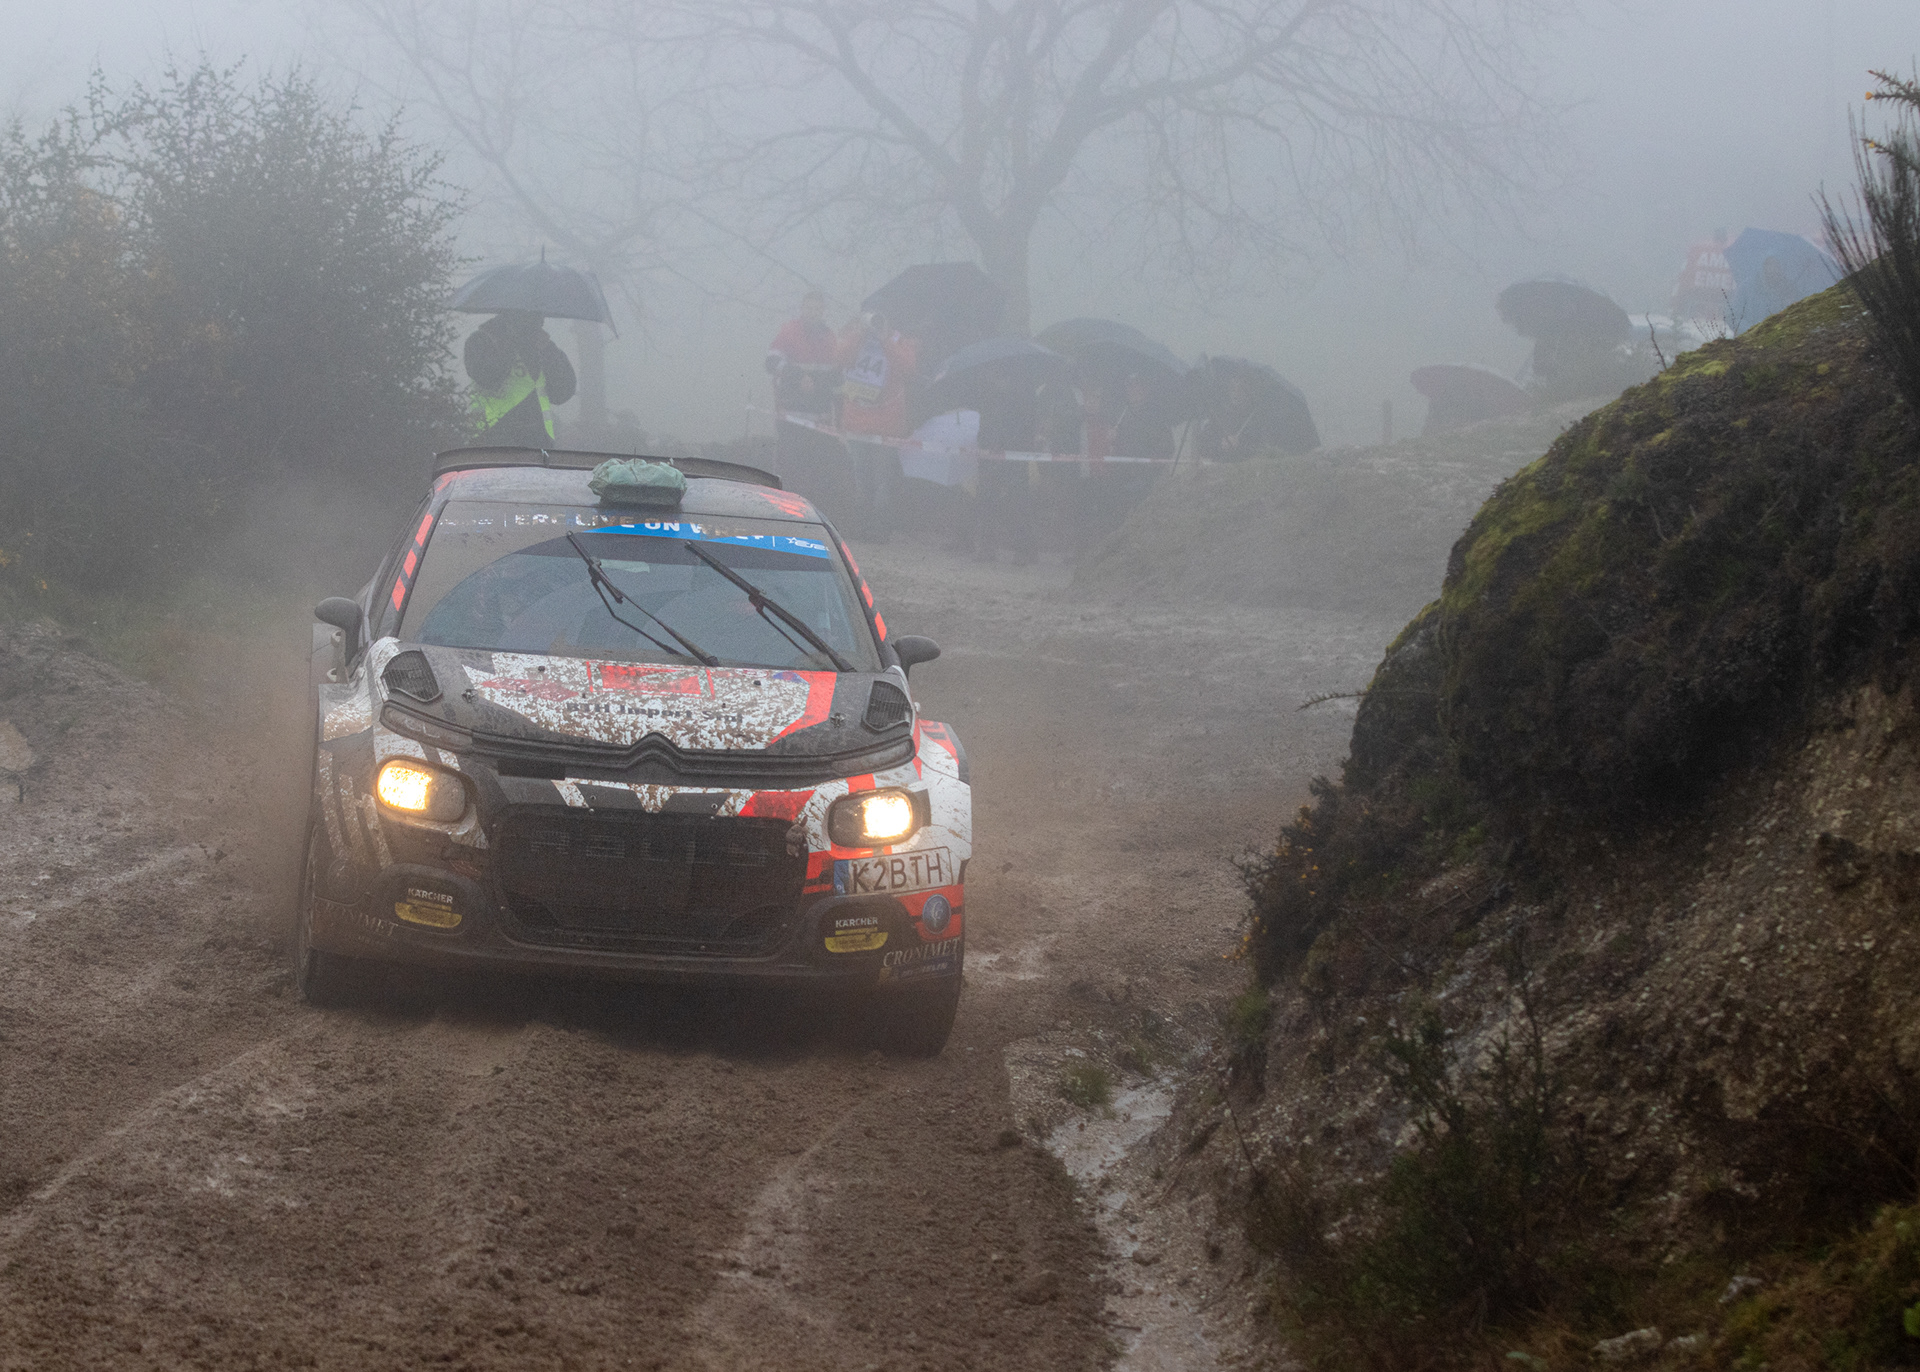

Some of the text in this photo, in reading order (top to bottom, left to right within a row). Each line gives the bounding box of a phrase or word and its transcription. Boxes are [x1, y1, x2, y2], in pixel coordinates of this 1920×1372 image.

[643, 518, 680, 533] ON
[619, 704, 693, 719] Import
[852, 853, 944, 894] K2BTH
[883, 937, 960, 967] CRONIMET
